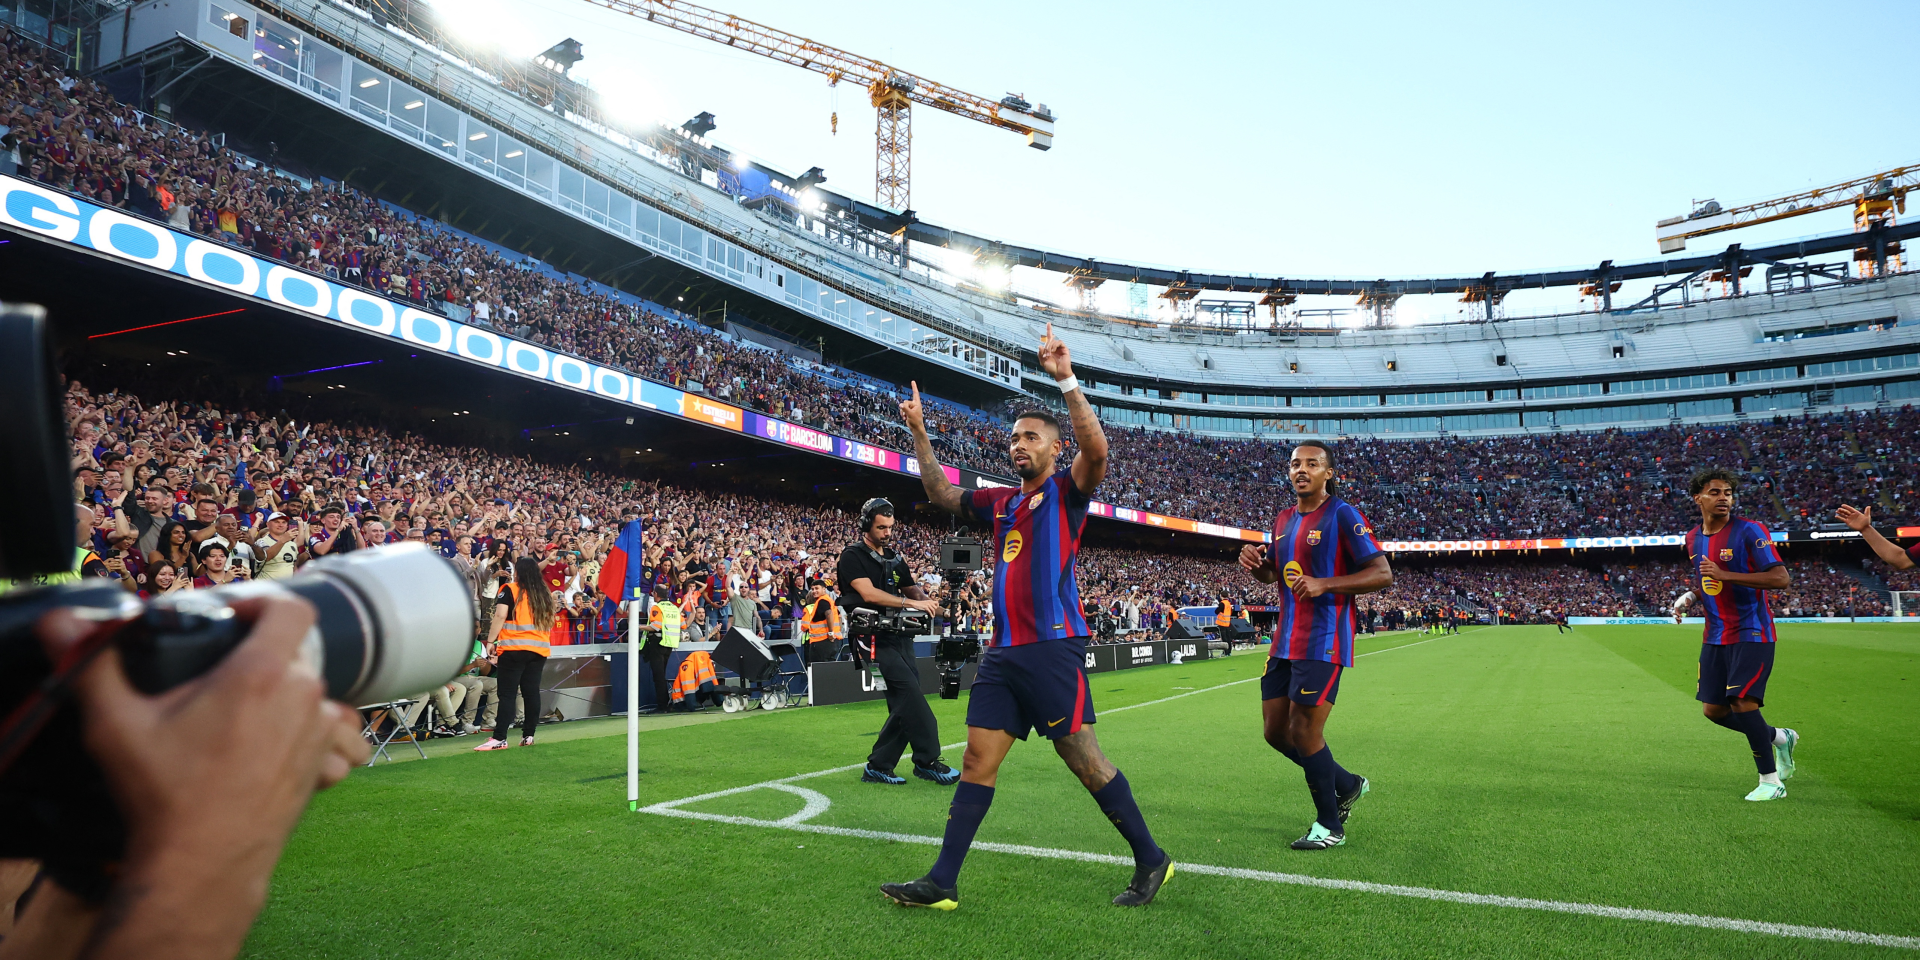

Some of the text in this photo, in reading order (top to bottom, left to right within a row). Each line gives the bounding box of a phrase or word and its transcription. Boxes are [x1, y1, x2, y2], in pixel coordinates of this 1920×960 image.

[780, 424, 790, 441] FC
[791, 428, 833, 453] BARCELONA
[845, 441, 852, 458] 2
[878, 450, 886, 466] 0
